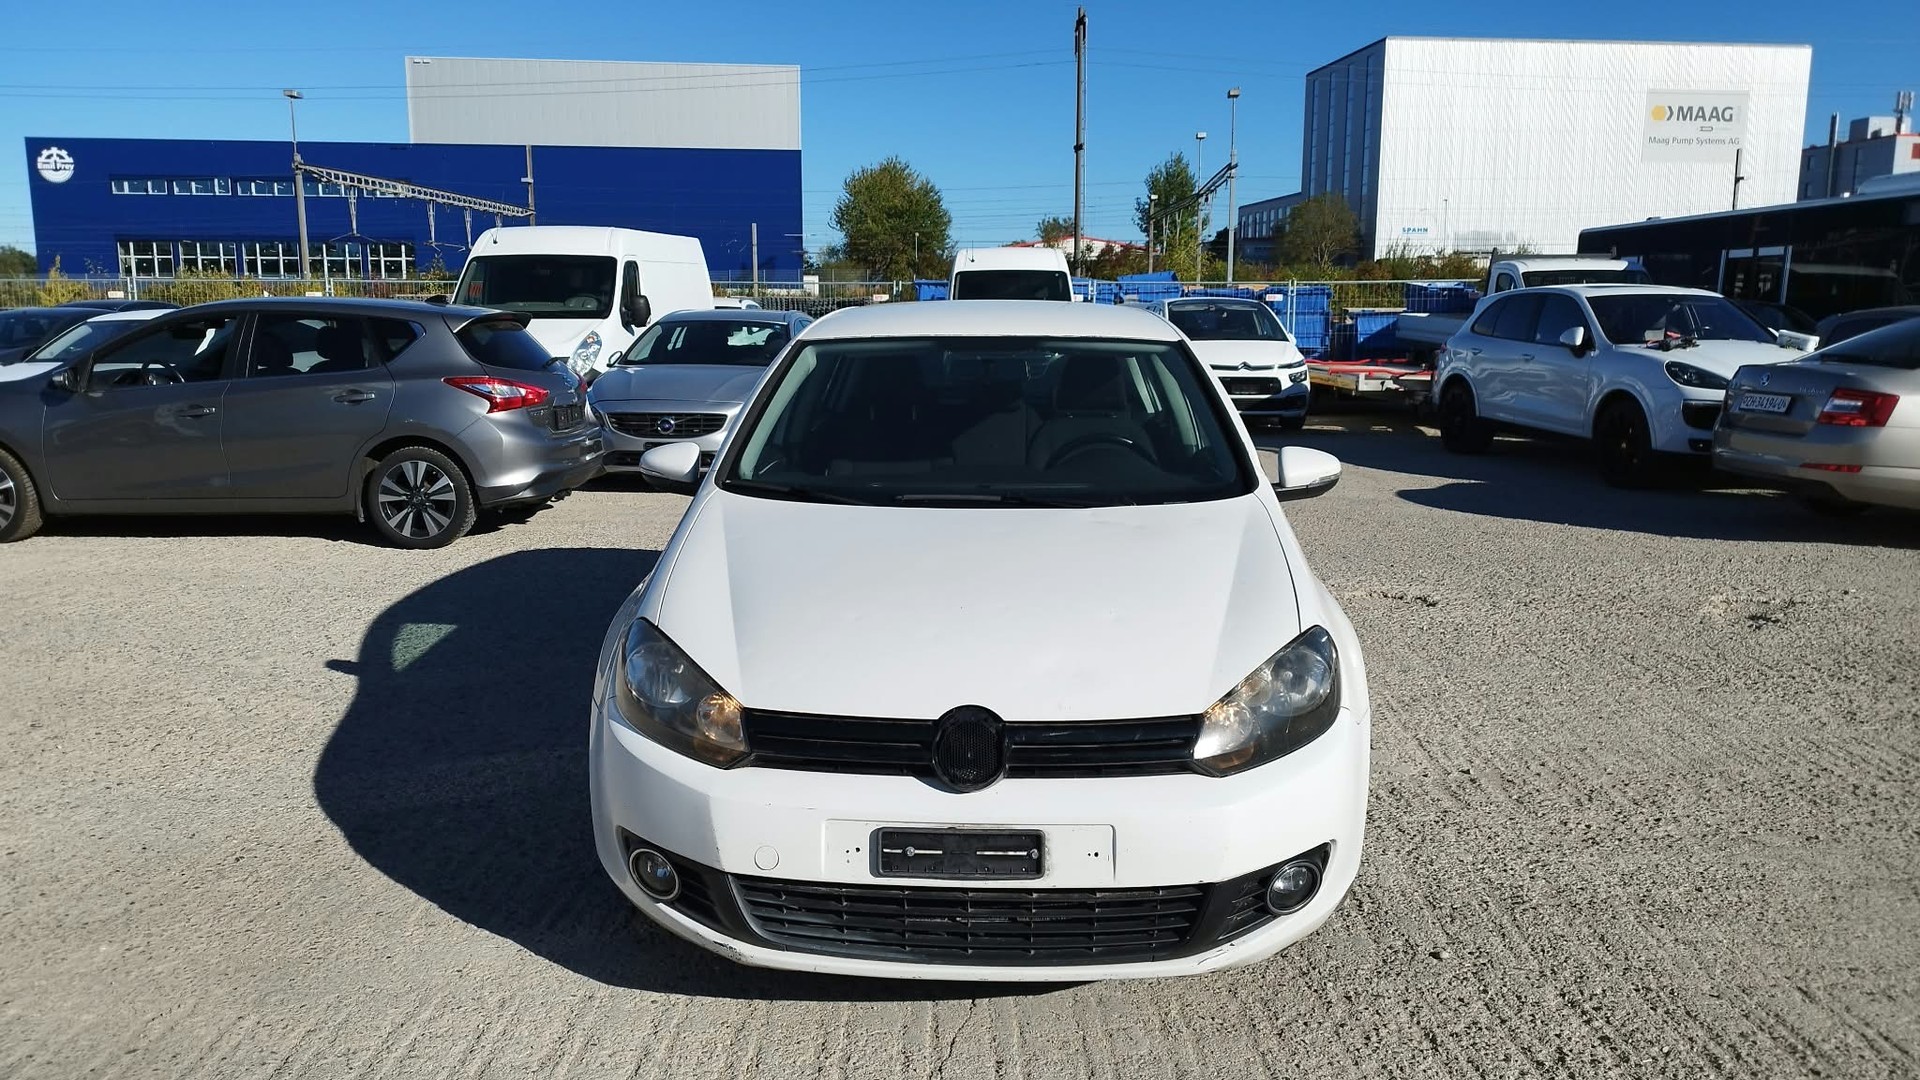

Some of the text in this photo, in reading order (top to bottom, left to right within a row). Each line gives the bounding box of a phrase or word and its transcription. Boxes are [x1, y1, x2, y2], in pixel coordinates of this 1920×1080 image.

[1676, 105, 1734, 122] MAAG
[1648, 136, 1740, 146] Maag Pump Systems AG
